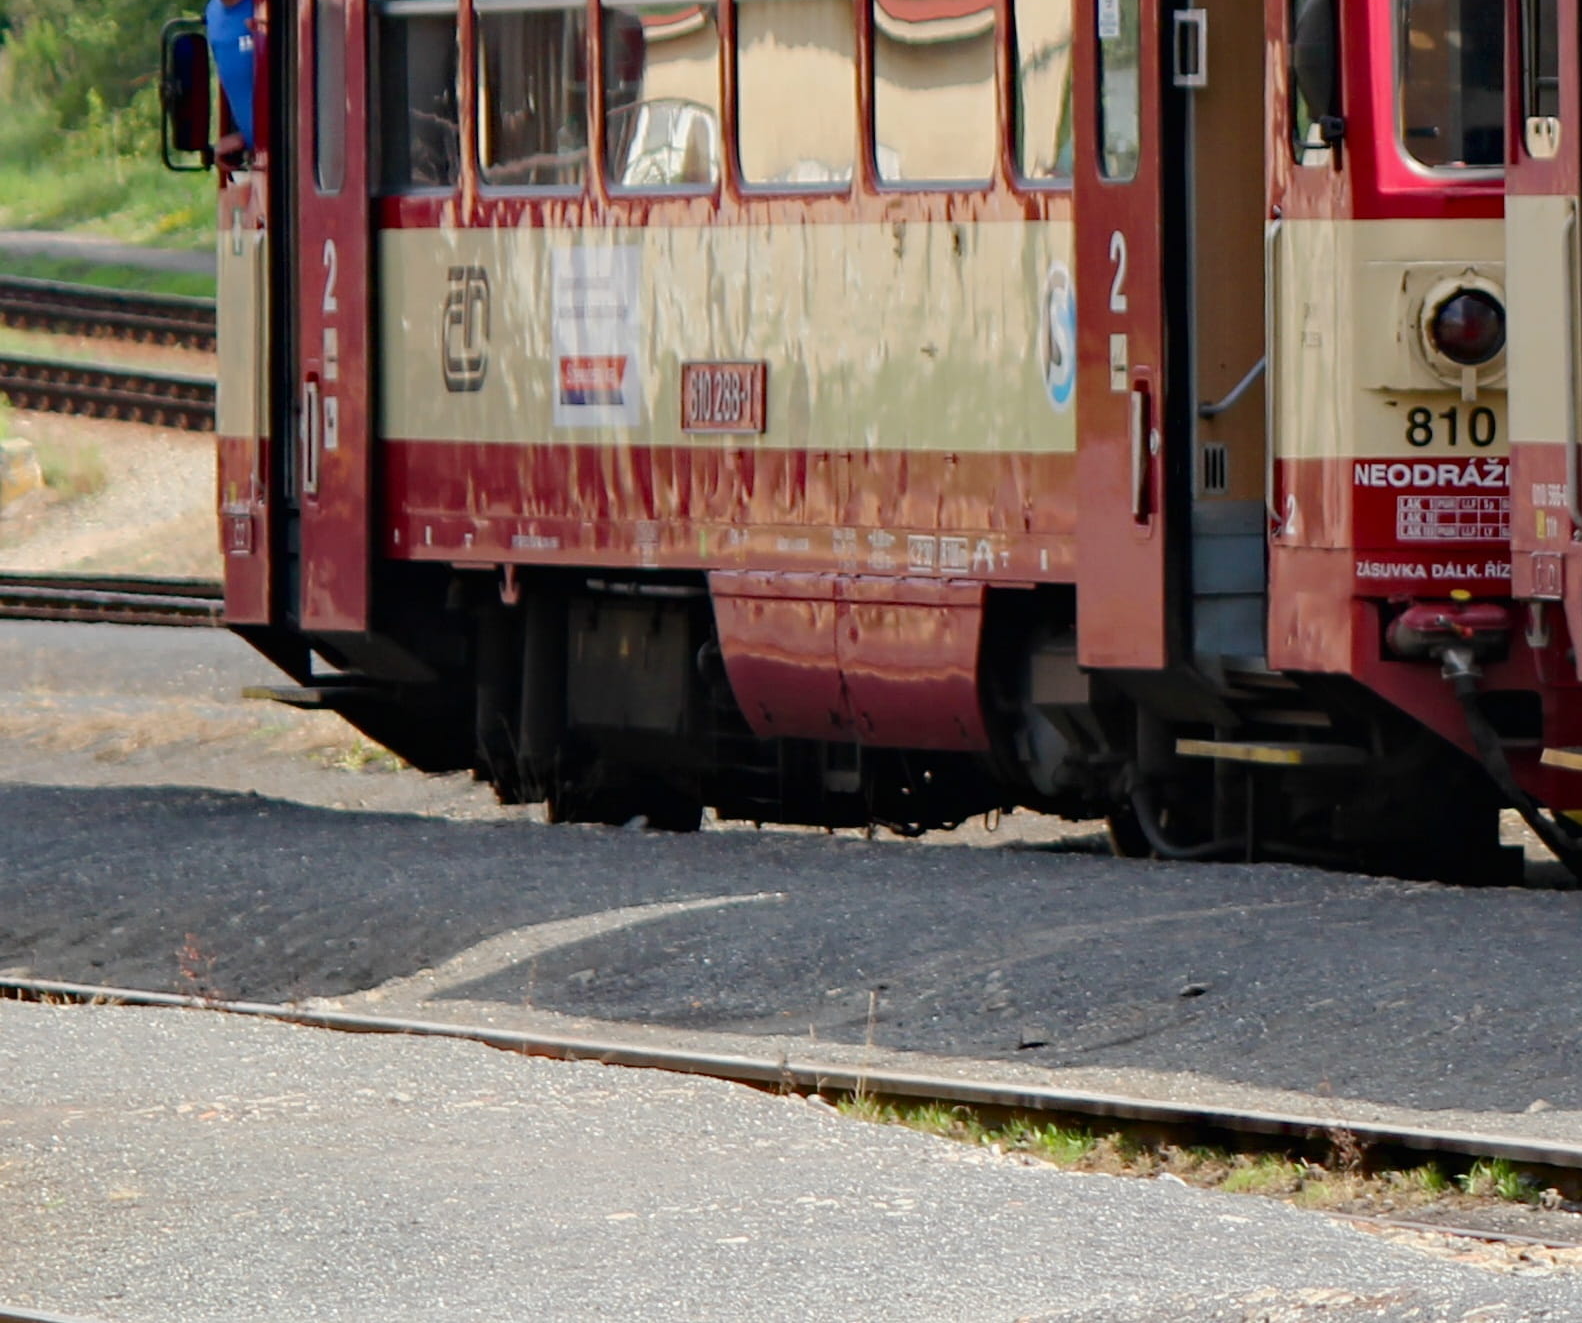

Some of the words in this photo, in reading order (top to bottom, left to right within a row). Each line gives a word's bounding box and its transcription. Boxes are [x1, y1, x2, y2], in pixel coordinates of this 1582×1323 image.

[323, 238, 338, 313] 2
[1109, 230, 1128, 312] 2
[690, 371, 712, 422] 810
[1405, 406, 1497, 448] 810
[1285, 493, 1297, 536] 2
[1400, 497, 1422, 511] LAK
[1400, 512, 1422, 523] LAK
[1400, 525, 1422, 537] LAK
[1355, 561, 1428, 578] ZÁSUVKA
[1431, 560, 1483, 578] DÁLK.
